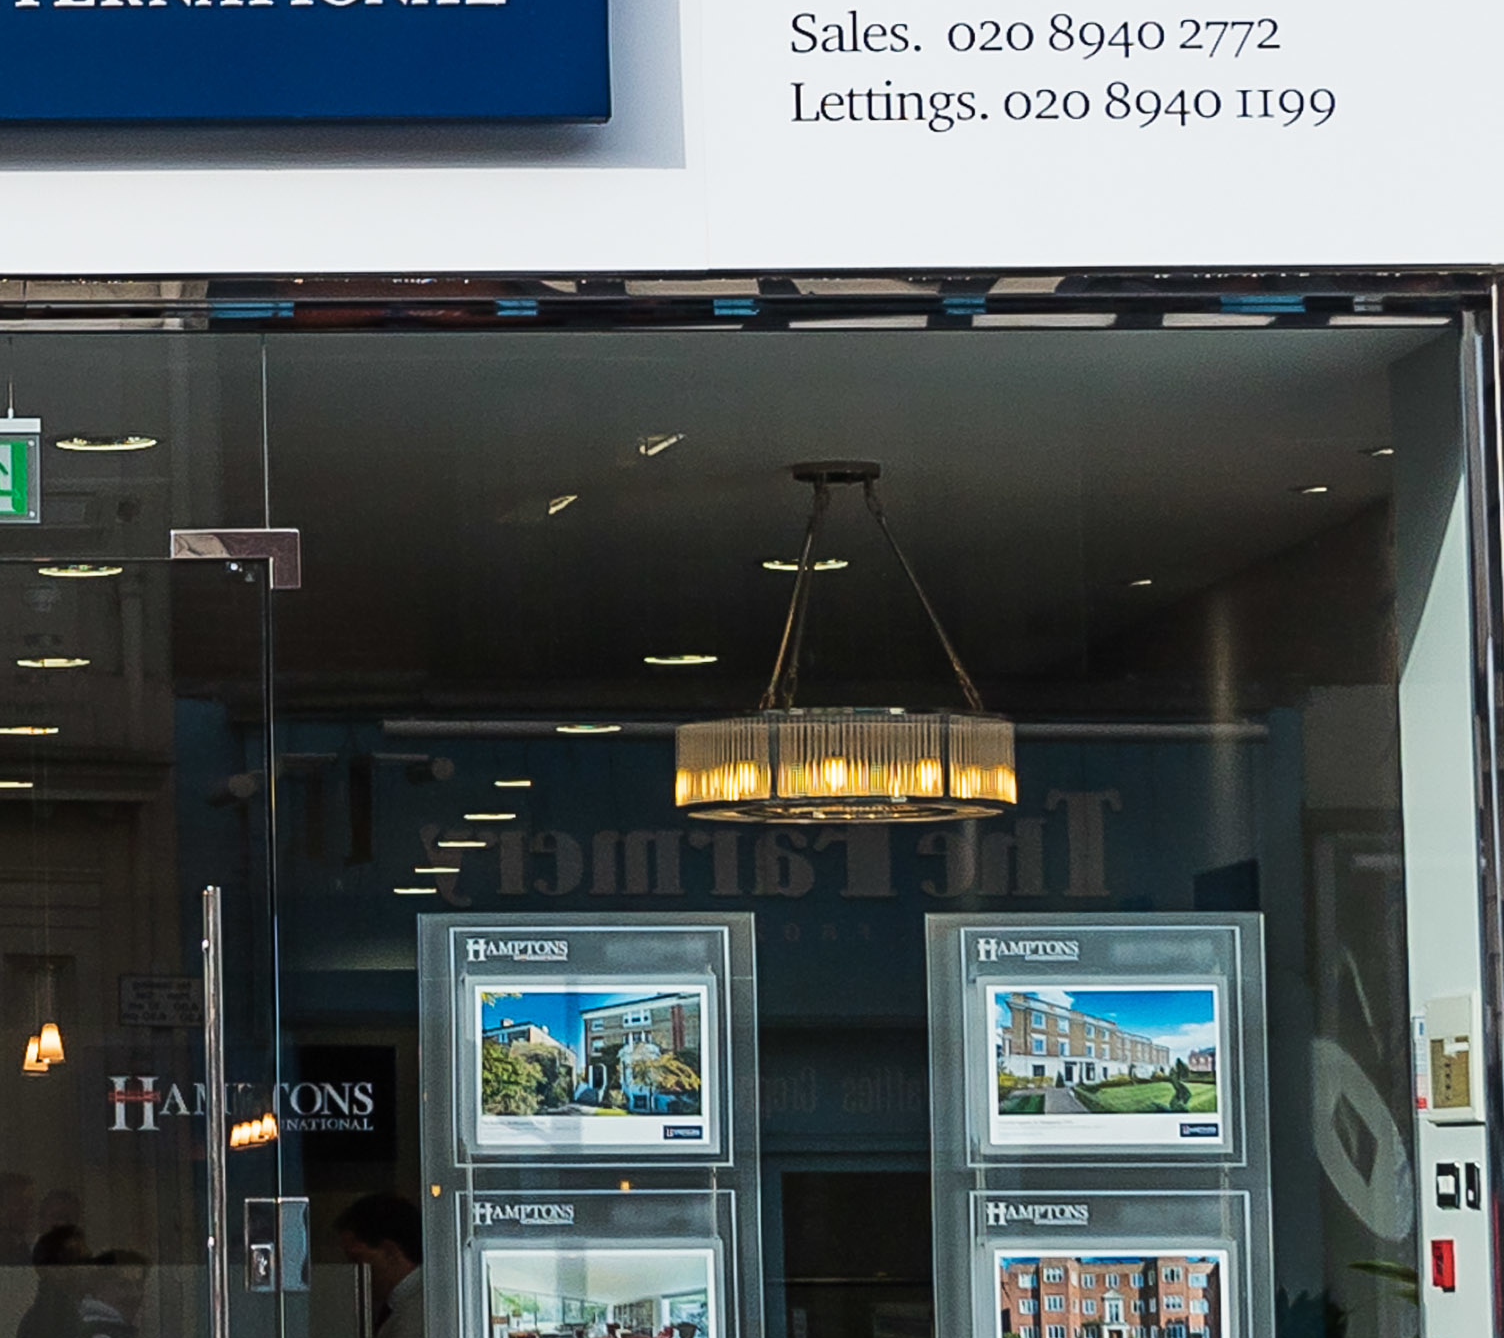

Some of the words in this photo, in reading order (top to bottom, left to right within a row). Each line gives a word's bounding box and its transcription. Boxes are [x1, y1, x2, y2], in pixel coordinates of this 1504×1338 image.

[790, 11, 922, 54] Sales.
[947, 19, 1034, 53] 020
[1048, 13, 1165, 60] 8940
[1178, 17, 1282, 59] 2772
[790, 80, 989, 133] Lettings.
[1003, 88, 1091, 122] 020
[1105, 81, 1222, 128] 8940
[1235, 88, 1337, 127] 1199
[466, 938, 568, 962] HAMPTONS
[977, 937, 1079, 962] HAMPTONS
[473, 1202, 575, 1225] HAMPTONS
[986, 1202, 1089, 1226] HAMPTONS
